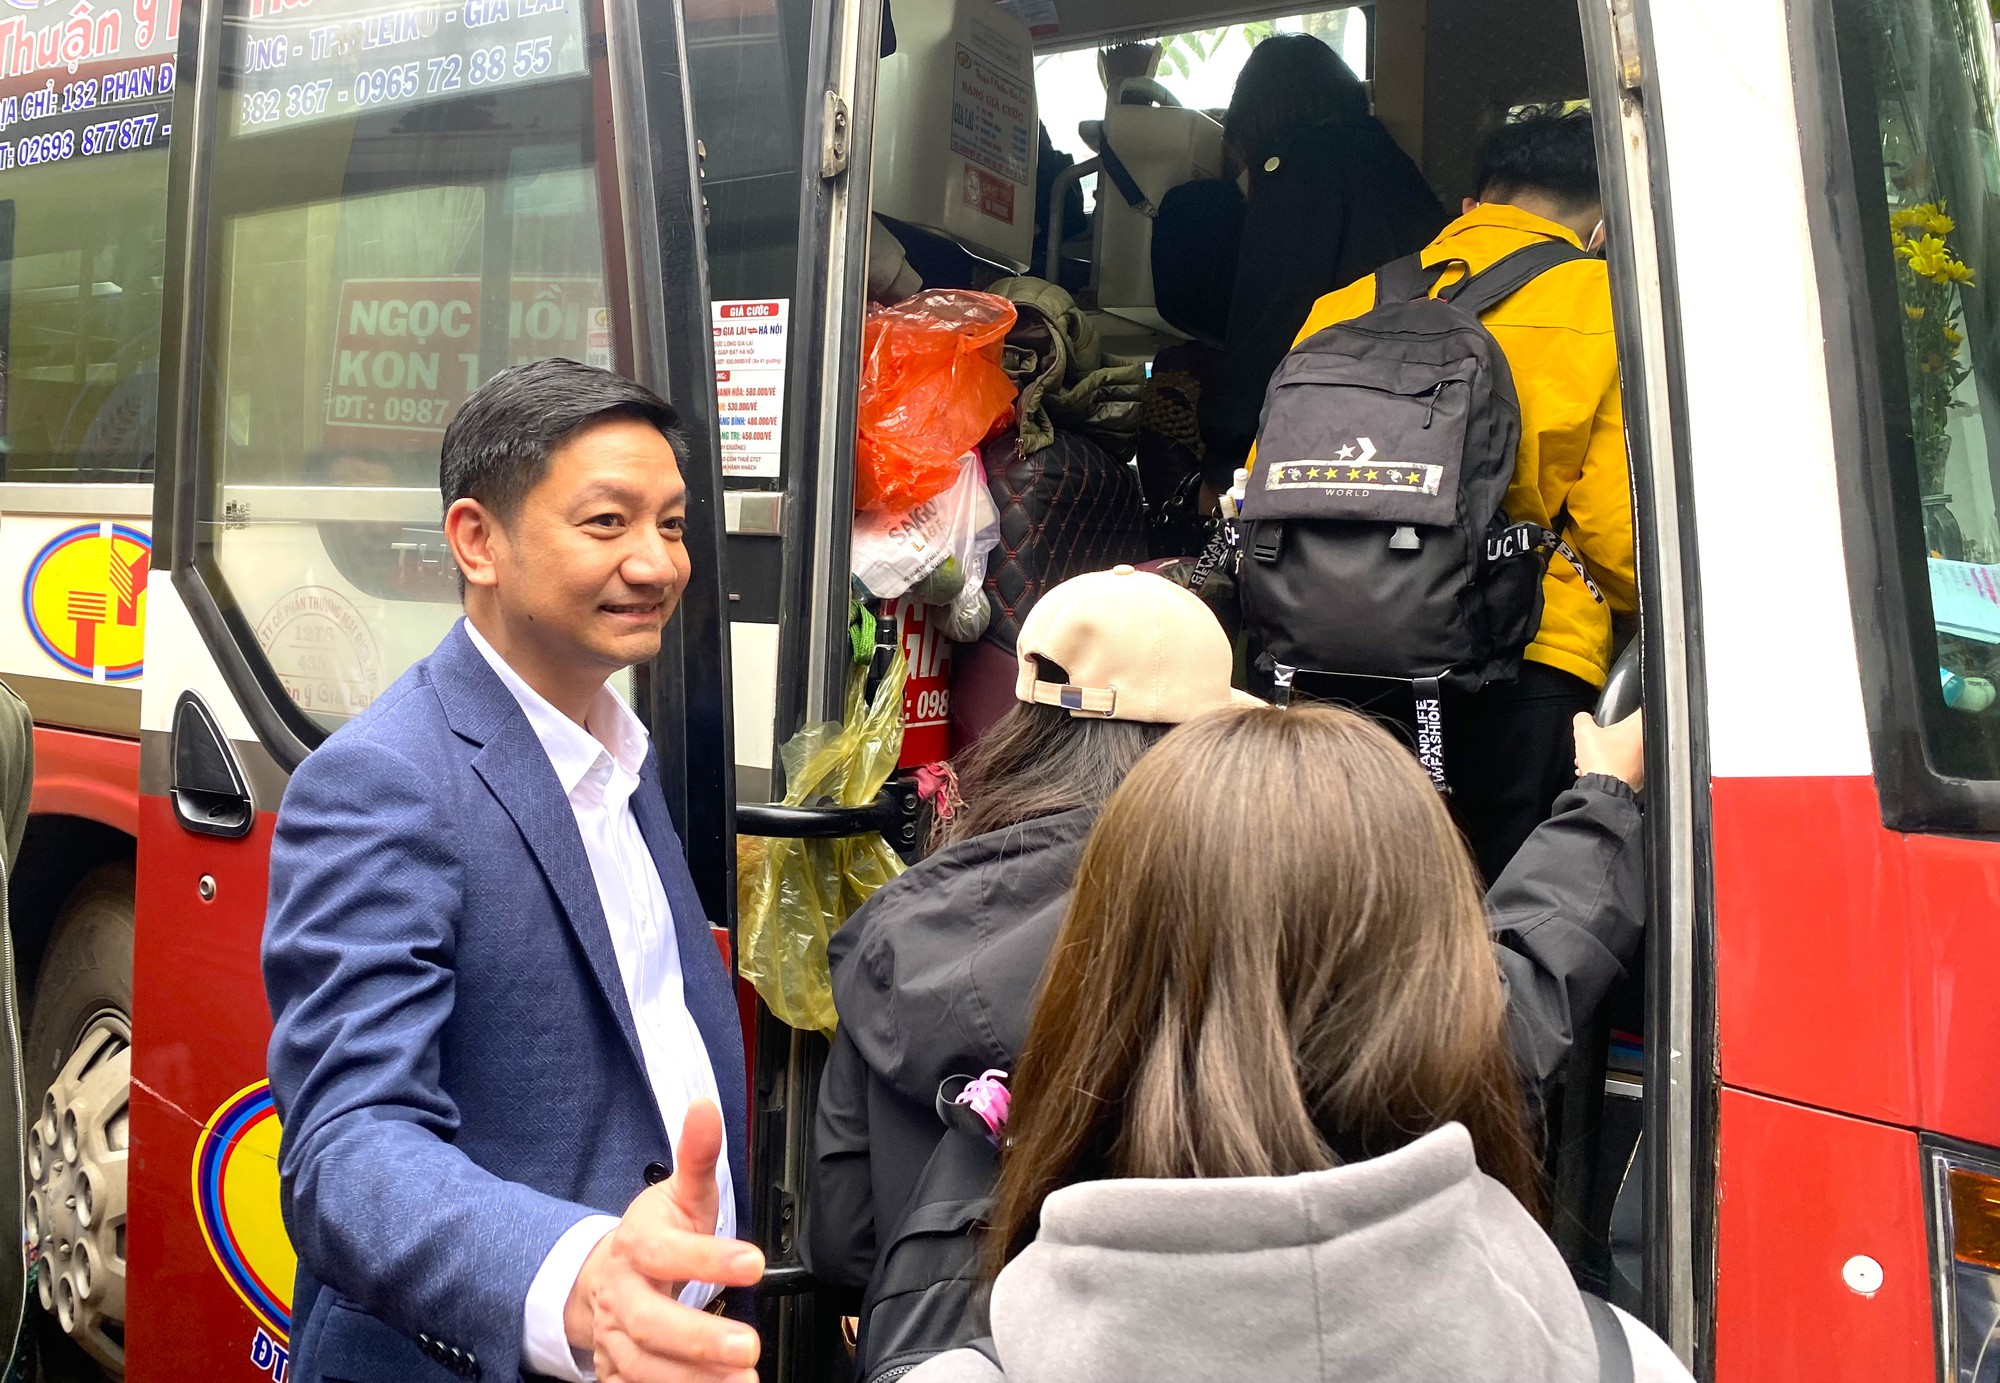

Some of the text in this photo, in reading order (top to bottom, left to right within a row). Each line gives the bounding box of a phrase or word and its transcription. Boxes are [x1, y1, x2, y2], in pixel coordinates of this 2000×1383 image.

[0, 96, 17, 132] ỊA
[21, 78, 58, 121] CHỈ:
[62, 79, 98, 112] 132
[101, 65, 155, 104] PHAN
[18, 128, 74, 167] 02693
[286, 79, 332, 117] 367
[354, 62, 420, 105] 0965
[427, 54, 462, 93] 72
[469, 46, 506, 85] 88
[513, 36, 552, 77] 55
[729, 304, 769, 317] GIÁ CƯỚC
[349, 299, 472, 345] NGỌC
[723, 327, 734, 336] GIA
[736, 326, 747, 335] LAI
[758, 323, 768, 335] HÀ
[770, 323, 782, 336] NỘI
[338, 349, 440, 391] KON
[334, 394, 450, 425] ĐT: 0987
[727, 400, 757, 411] 530.000/VÉ
[742, 430, 771, 440] 450.000/VÉ
[1325, 489, 1370, 497] WORLD
